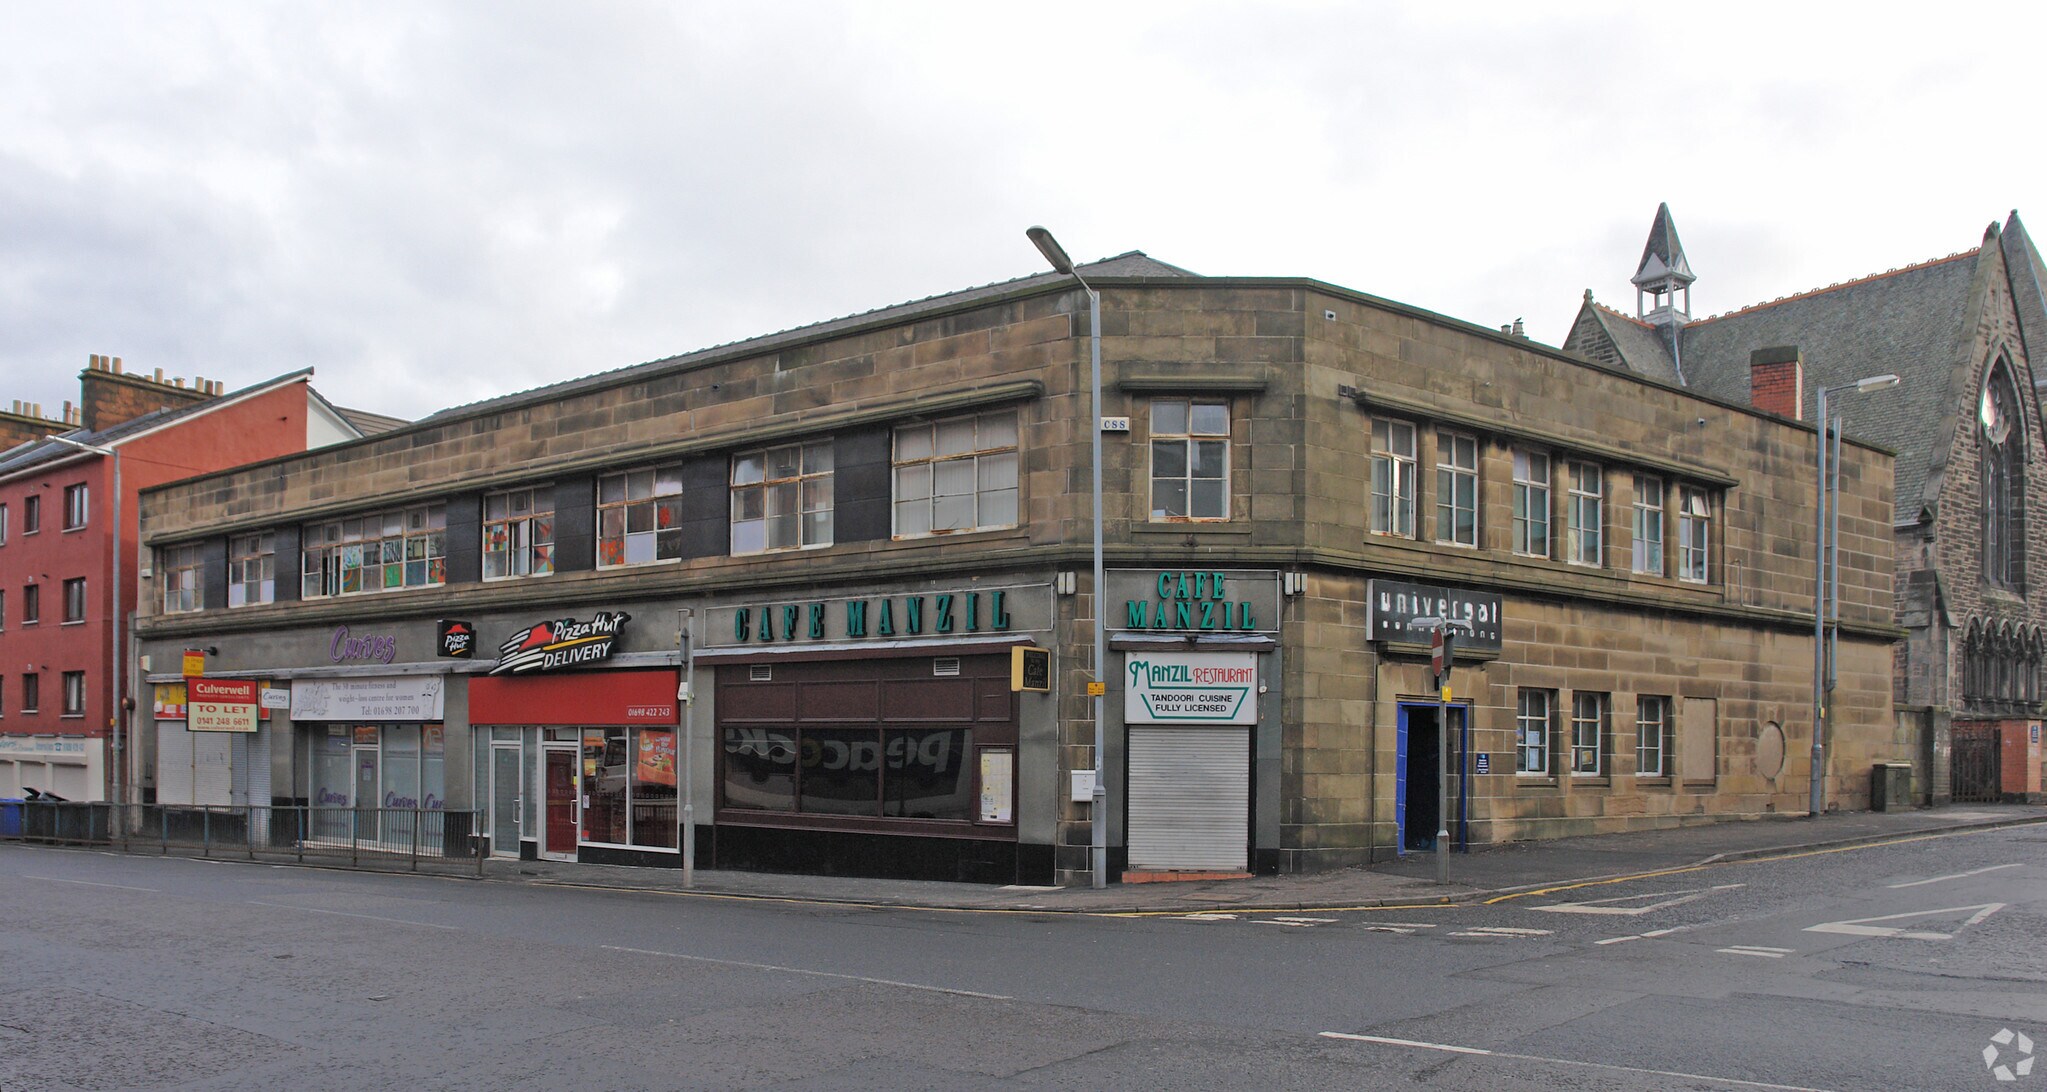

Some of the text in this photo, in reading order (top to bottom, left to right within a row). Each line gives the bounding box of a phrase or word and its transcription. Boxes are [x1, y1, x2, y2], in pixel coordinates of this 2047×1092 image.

[1104, 420, 1126, 429] CSS
[1158, 571, 1226, 600] CAFE
[734, 590, 1011, 642] CAFE MANZIL
[1126, 600, 1257, 631] MANZIL
[1380, 590, 1498, 625] universal
[551, 613, 624, 644] Pizza Hut
[330, 624, 395, 664] Curves
[445, 634, 470, 652] Pizza Hut
[543, 641, 612, 668] DELIVERY
[1129, 660, 1254, 689] MANZIL RESTAURANT
[196, 683, 250, 695] Culverwell
[332, 682, 341, 691] The
[368, 680, 386, 690] fitness
[386, 679, 397, 689] and
[368, 693, 384, 702] centre
[385, 692, 394, 701] for
[1150, 693, 1233, 703] TANDOORI CUISINE
[197, 704, 249, 714] TO LET
[361, 705, 420, 716] Tel: 01698 207 700
[628, 707, 670, 717] 01698 422 243
[1155, 704, 1227, 713] FULLY LICENSED
[197, 717, 214, 726] 0141
[217, 717, 231, 726] 248
[318, 787, 347, 807] Curves
[385, 790, 418, 808] Curves
